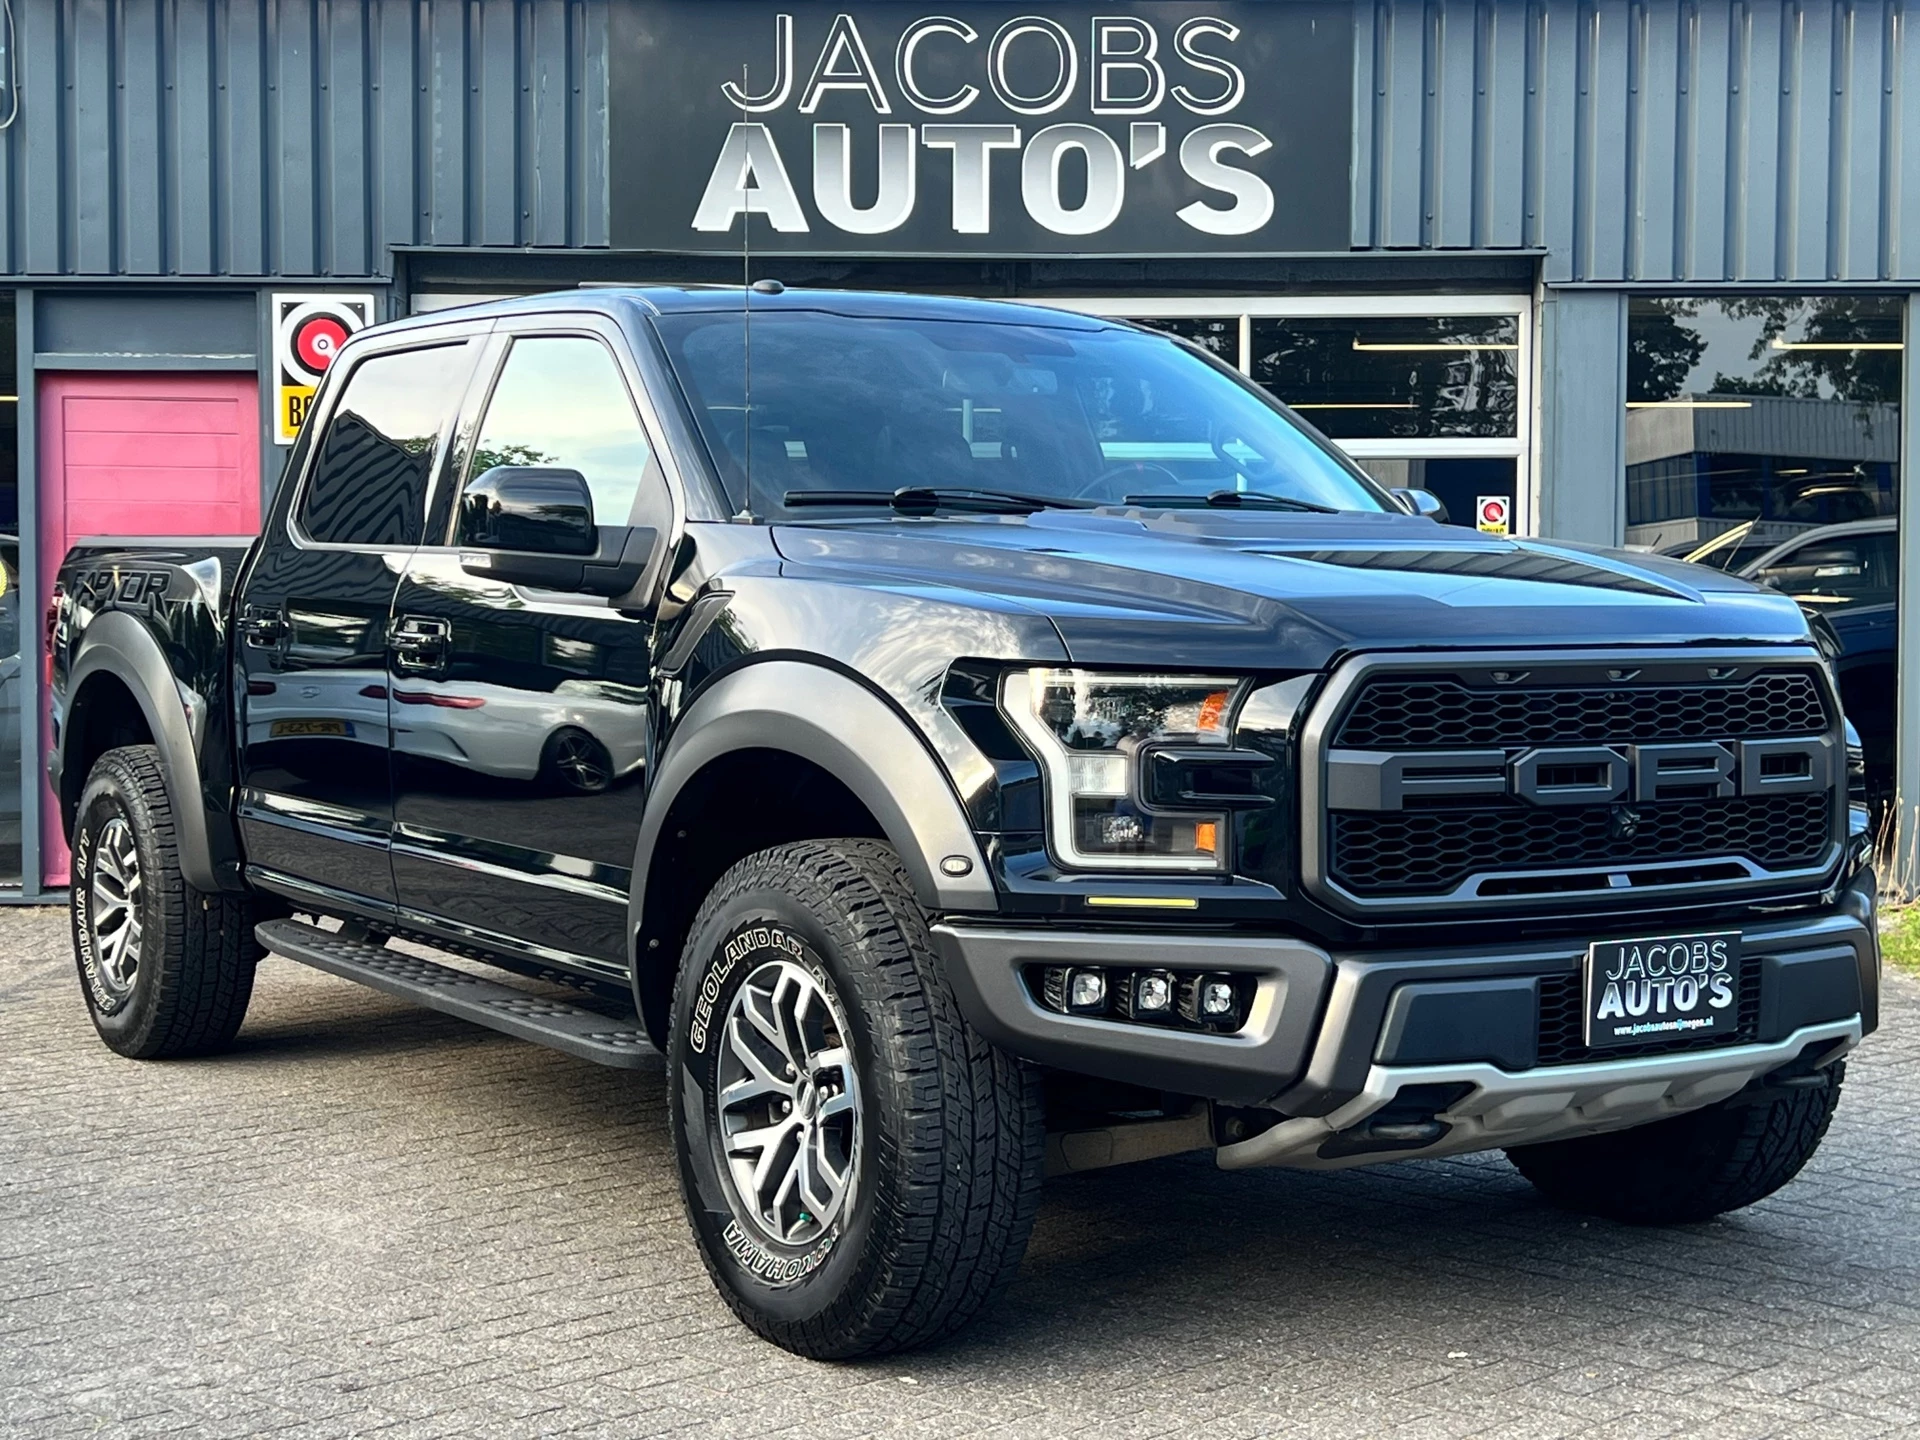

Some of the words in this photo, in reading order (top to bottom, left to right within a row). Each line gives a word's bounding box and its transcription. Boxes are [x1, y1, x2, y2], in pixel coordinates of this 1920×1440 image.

[720, 13, 1246, 115] JACOBS
[691, 122, 1275, 235] AUTO'S
[1327, 737, 1834, 811] FORD
[690, 927, 804, 1053] GEOLANDAR
[1596, 972, 1734, 1020] AUTO'S
[1605, 940, 1728, 981] JACOBS
